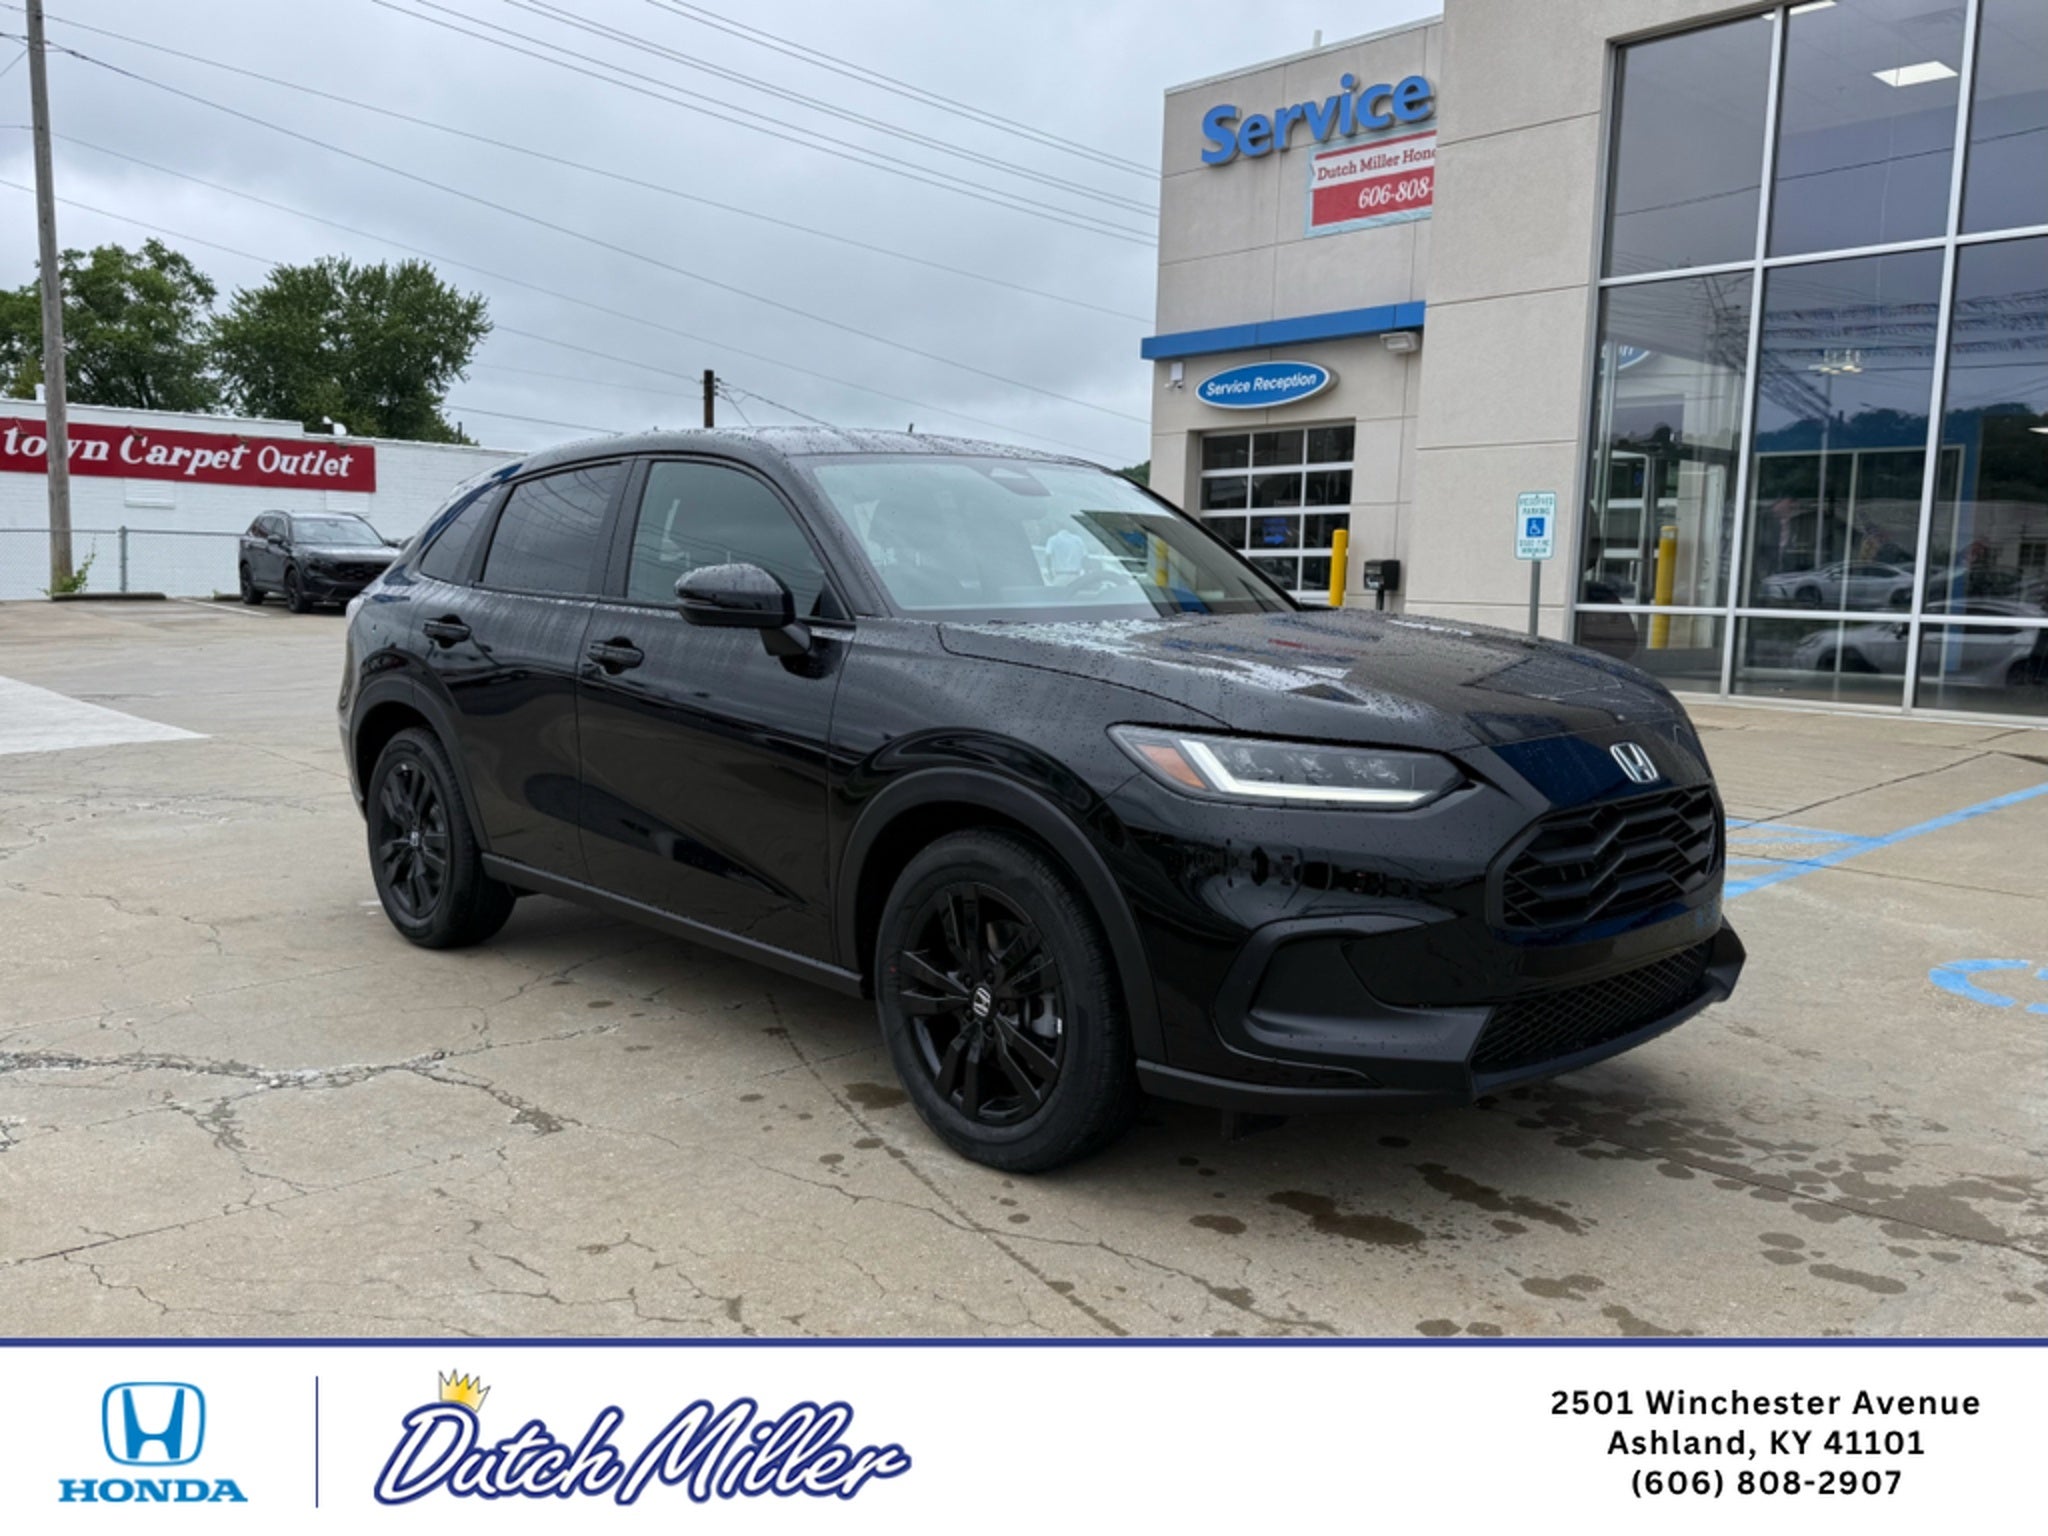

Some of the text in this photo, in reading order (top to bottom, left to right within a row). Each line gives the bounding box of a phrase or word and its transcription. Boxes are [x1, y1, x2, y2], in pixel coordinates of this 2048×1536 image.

[1201, 73, 1434, 166] Service
[1317, 161, 1357, 181] Dutch
[1360, 153, 1400, 173] Miller
[1206, 372, 1317, 397] Service Reception
[119, 434, 250, 476] Carpet
[257, 445, 353, 477] Outlet
